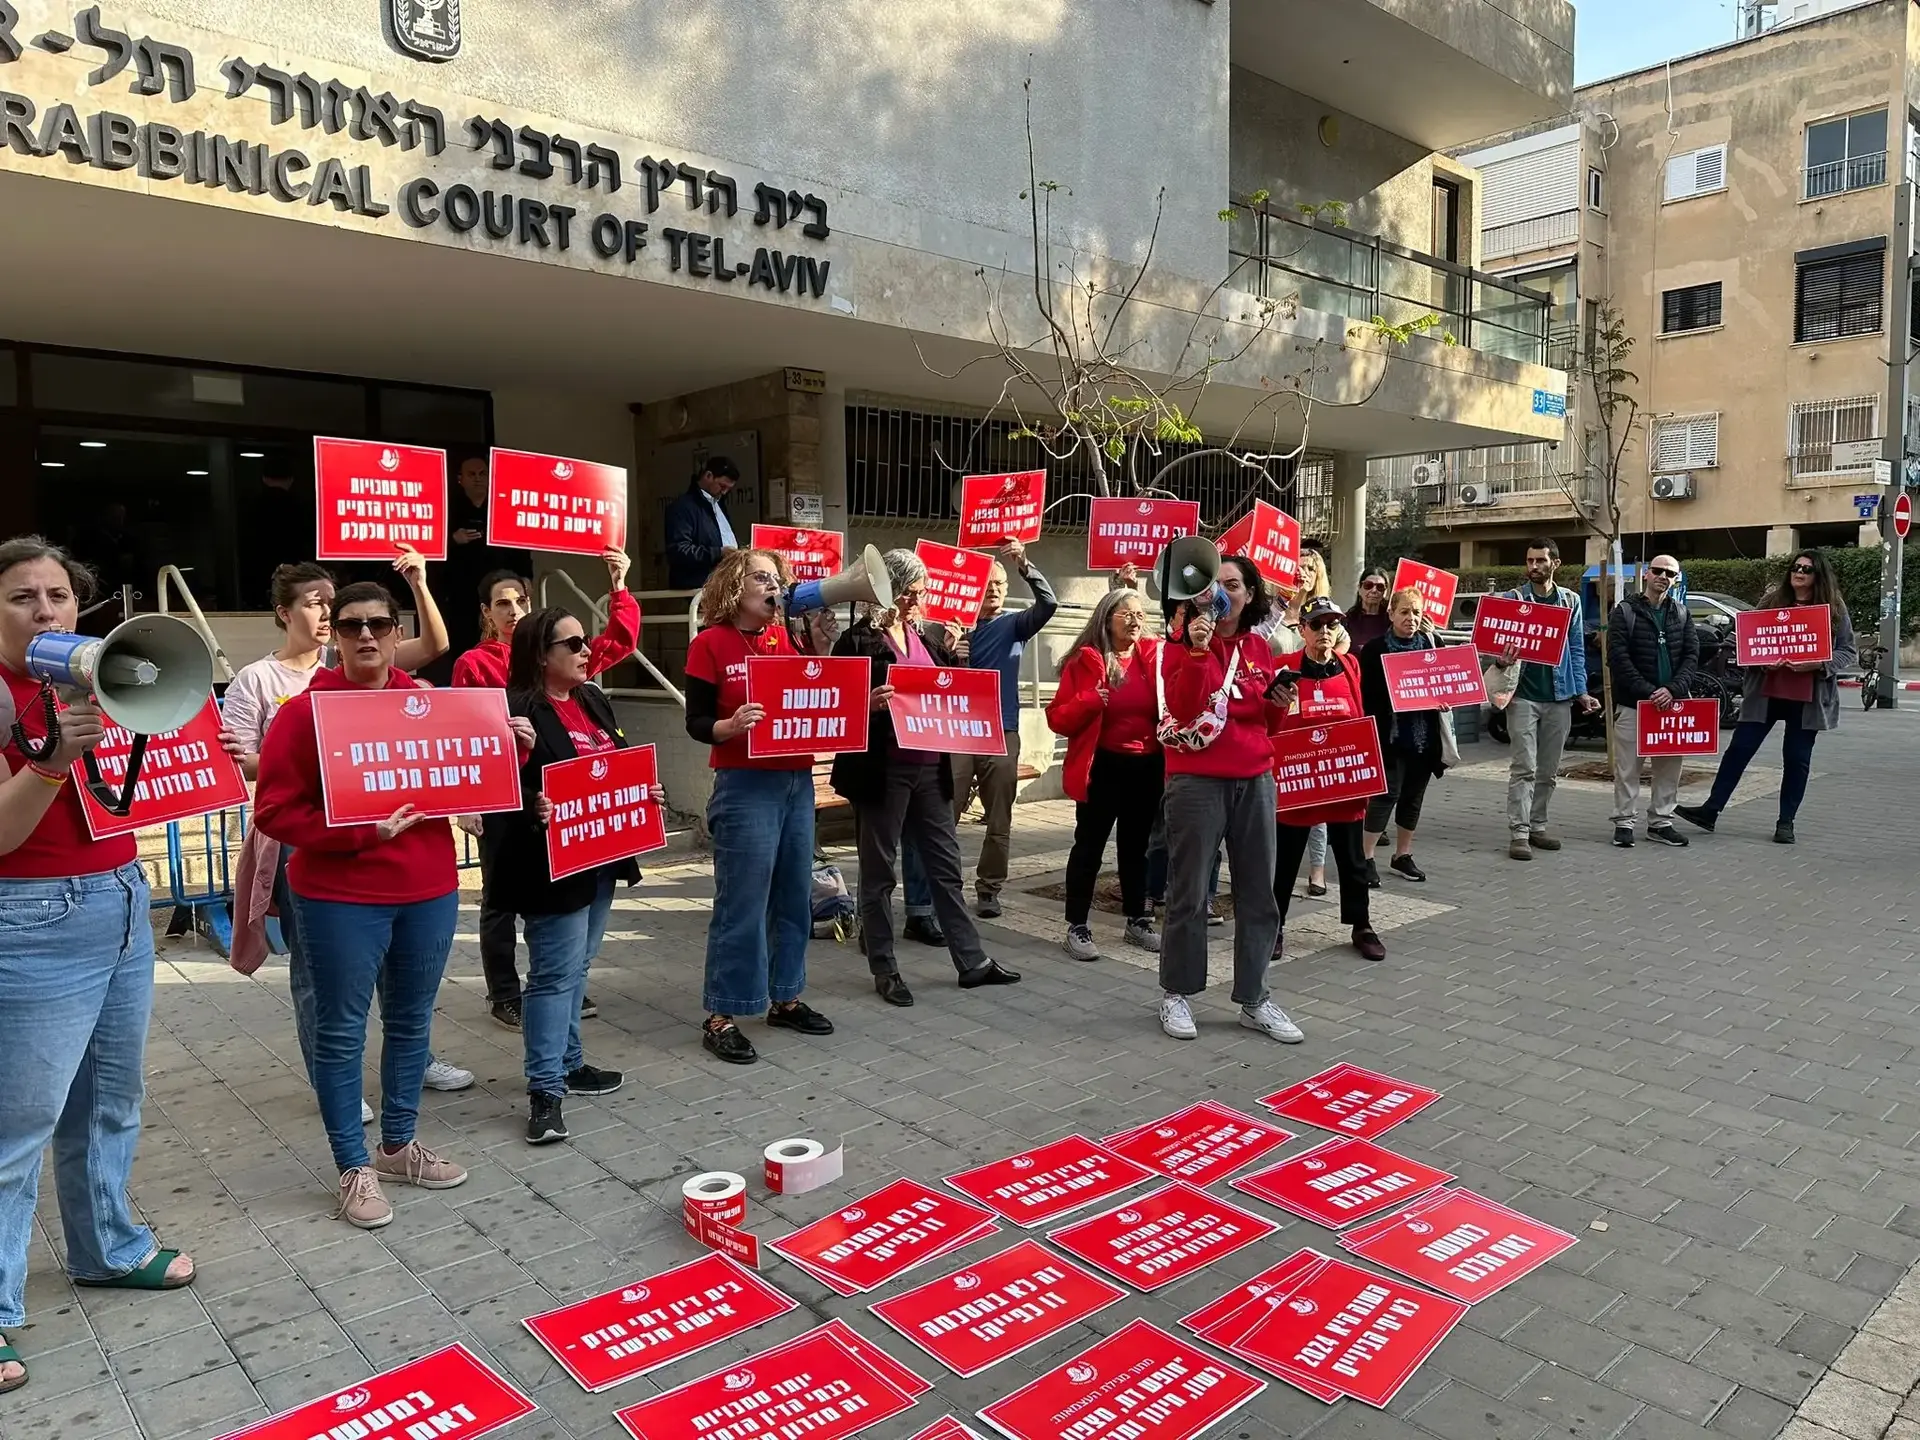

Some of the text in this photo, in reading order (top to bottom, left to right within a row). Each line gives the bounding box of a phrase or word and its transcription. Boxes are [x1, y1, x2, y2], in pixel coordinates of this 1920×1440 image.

[220, 57, 447, 157] האזורי
[463, 114, 622, 193] הרבני
[0, 91, 831, 298] RABBINICAL COURT OF TEL-AVIV
[637, 155, 738, 218] הדין
[754, 182, 830, 240] בית
[792, 371, 802, 385] 33
[1534, 393, 1543, 408] 33
[351, 477, 422, 497] יותר סמכויות
[511, 489, 618, 517] בית דין דתי חזק
[337, 499, 433, 519] לבתי הדין הדתיים
[516, 511, 602, 535] אישה חלשה
[341, 521, 433, 541] זה מדרון חלקלק
[1099, 523, 1169, 539] לא בהסכמה
[1482, 616, 1560, 639] זה לא בהסכמה
[1748, 633, 1817, 645] לבתי הדין הדתיים
[1757, 624, 1808, 635] יותר סמכויות
[1531, 639, 1542, 651] זו
[1751, 644, 1817, 657] זה מדרון חלקלק
[782, 687, 840, 709] למעשה
[920, 693, 970, 714] אין דין
[772, 716, 847, 740] זאת הלכה
[905, 715, 992, 738] כשאין דיינת
[1646, 731, 1710, 745] כשאין דיינת
[1661, 716, 1695, 730] אין דין
[174, 741, 209, 764] לבתי
[350, 736, 501, 766] בית דין דתי חזק
[151, 772, 194, 801] מדרון
[198, 767, 216, 788] זה
[363, 764, 482, 793] אישה חלשה
[1318, 772, 1345, 788] חינוך
[554, 783, 648, 823] השנה היא 2024
[561, 806, 647, 848] לא ימי הביניים
[1323, 1089, 1373, 1115] אין דין
[1337, 1090, 1414, 1130] כשאין דיינת
[994, 1154, 1108, 1199] בית דין דתי חזק
[1017, 1170, 1110, 1206] אישה חלשה
[1305, 1162, 1377, 1192] למעשה
[1326, 1172, 1417, 1210] זאת הלכה
[817, 1197, 941, 1264] זה לא בהסכמה
[863, 1217, 947, 1262] זו כפייה!
[1108, 1211, 1186, 1250] יותר סמכויות
[1113, 1213, 1221, 1266] לבתי הדין הדתיים
[1417, 1223, 1491, 1263] למעשה
[1135, 1223, 1241, 1275] זה מדרון חלקלק
[1447, 1234, 1538, 1283] זאת הלכה
[580, 1280, 744, 1351] בית דין דתי חזק
[918, 1266, 1066, 1338] זה לא בהסכמה
[968, 1291, 1068, 1343] זו כפייה!
[604, 1302, 737, 1361] אישה חלשה
[1293, 1283, 1391, 1369] השנה היא 2024
[1331, 1297, 1421, 1378] לא ימי הביניים
[1128, 1358, 1155, 1375] מתוך
[1099, 1373, 1131, 1393] מגילת
[1113, 1356, 1189, 1414] "חופש דת,
[1136, 1366, 1227, 1426] לשון, חינוך
[690, 1373, 812, 1431] יותר סמכויות
[759, 1379, 851, 1426] לבתי הדין
[839, 1394, 870, 1413] זה
[405, 1403, 477, 1440] זאת
[780, 1406, 842, 1440] מדרון
